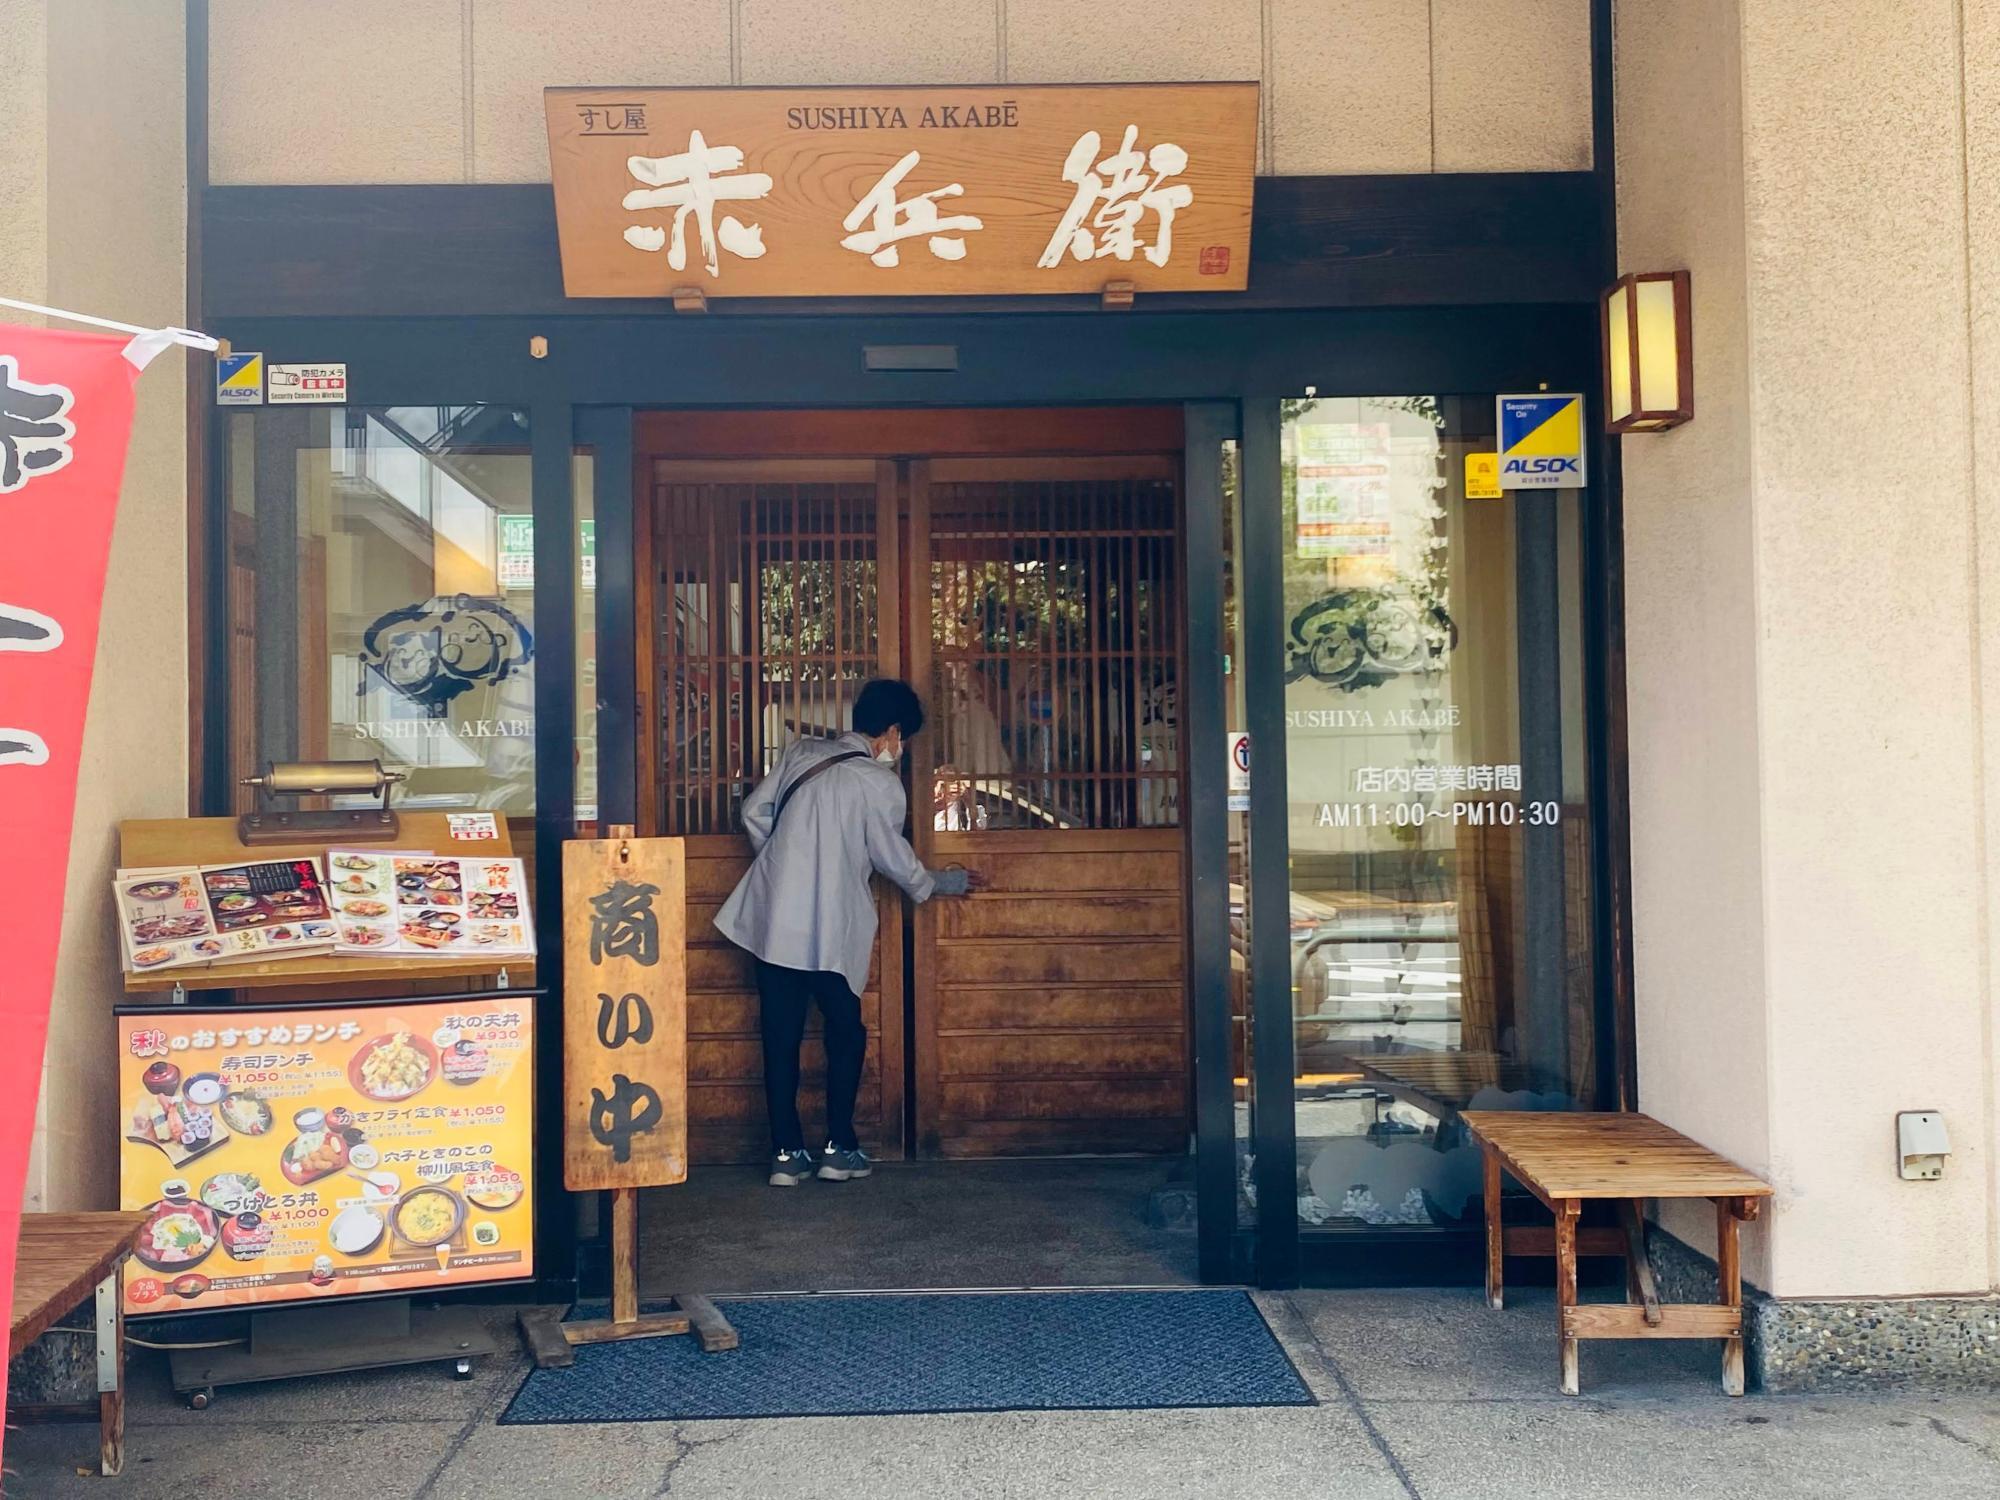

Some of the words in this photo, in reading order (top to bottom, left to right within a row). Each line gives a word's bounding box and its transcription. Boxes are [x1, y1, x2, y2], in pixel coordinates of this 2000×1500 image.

[578, 108, 646, 132] すし屋
[787, 106, 908, 130] SUSHIYA
[623, 125, 1194, 277] 赤兵衛
[220, 389, 258, 397] ALSOK
[1504, 458, 1578, 473] ALSOK
[355, 720, 450, 739] SUSHIYA
[1356, 764, 1521, 793] 店内営業時間
[445, 1013, 520, 1029] 秋の天丼
[588, 880, 664, 1164] 商い中
[130, 1021, 361, 1057] 秋のおすすめランチ
[476, 1030, 519, 1041] ¥930
[220, 1052, 314, 1071] 寿司ランチ
[339, 1106, 448, 1125] かきフライ定食
[384, 1144, 493, 1163] 穴子ときのこの
[416, 1161, 495, 1177] 柳川風定食
[223, 1192, 319, 1212] づけとろ丼
